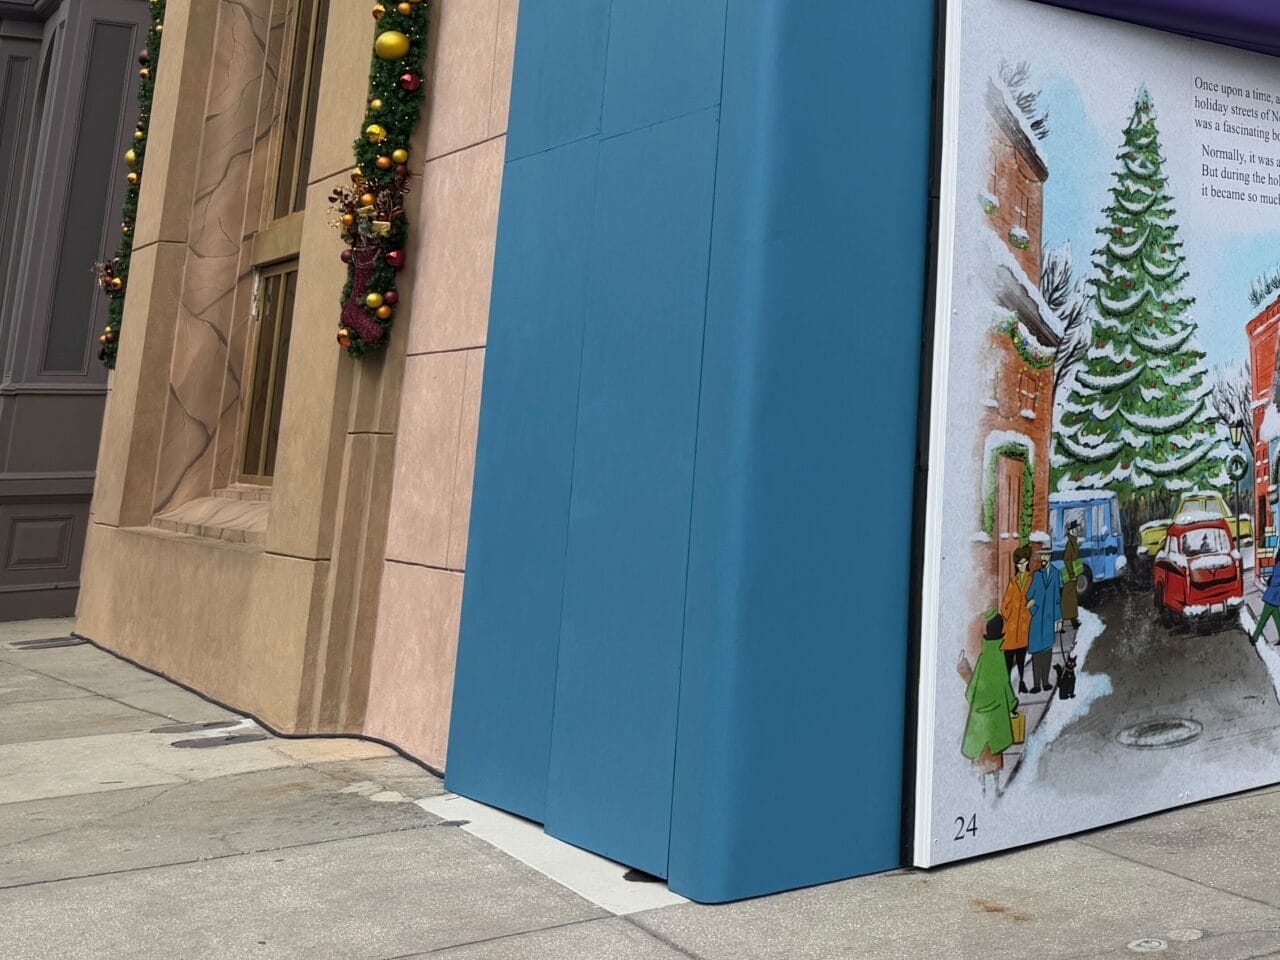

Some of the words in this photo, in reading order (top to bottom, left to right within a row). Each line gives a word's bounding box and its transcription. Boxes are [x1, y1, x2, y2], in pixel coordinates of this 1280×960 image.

[1194, 76, 1219, 92] Once
[1221, 85, 1243, 99] upon
[1245, 89, 1251, 98] a
[1252, 88, 1274, 104] time,
[1194, 96, 1229, 116] holiday
[1230, 104, 1259, 119] streets
[1260, 110, 1271, 121] of
[1194, 118, 1213, 131] was
[1214, 121, 1221, 131] a
[1223, 120, 1270, 143] fascinating
[1201, 144, 1247, 165] Normally,
[1249, 150, 1256, 164] it
[1258, 155, 1274, 167] was
[1201, 164, 1219, 178] But
[1220, 166, 1250, 186] during
[1252, 171, 1266, 184] the
[1201, 184, 1208, 197] it
[1210, 185, 1246, 202] became
[1247, 192, 1258, 202] so
[953, 813, 978, 841] 24
